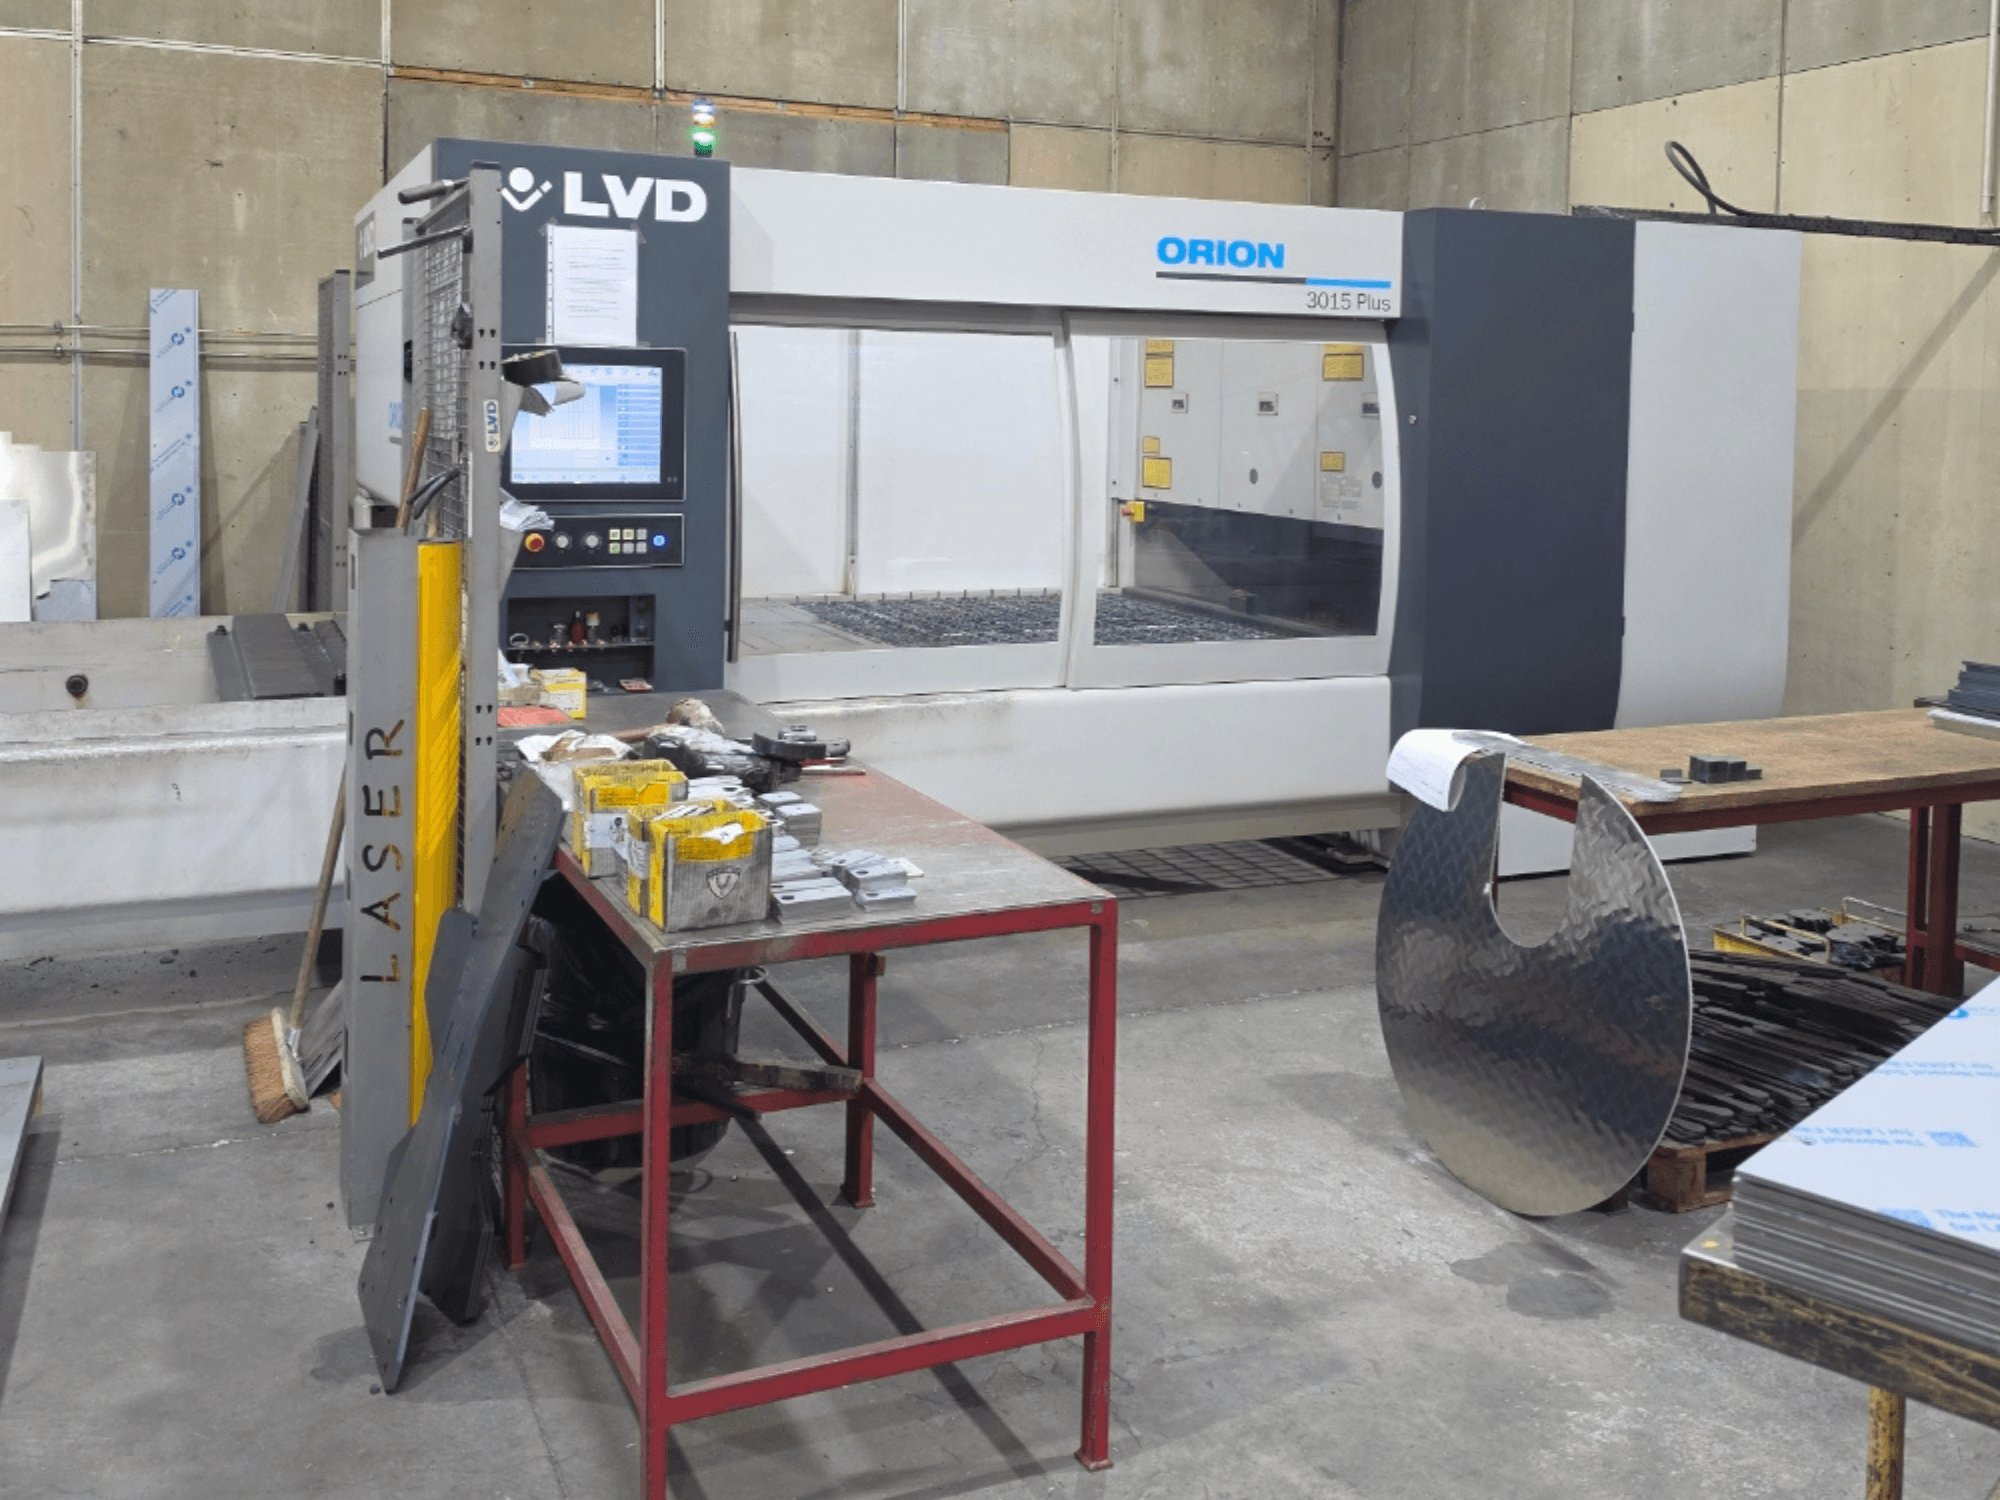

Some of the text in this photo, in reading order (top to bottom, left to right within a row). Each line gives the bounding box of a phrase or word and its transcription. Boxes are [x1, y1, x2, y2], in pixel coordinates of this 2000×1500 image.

[563, 170, 708, 222] LVD
[1156, 236, 1286, 269] ORION
[1306, 291, 1392, 312] 3015 Plus
[485, 401, 498, 434] LVD
[359, 718, 405, 983] LASER
